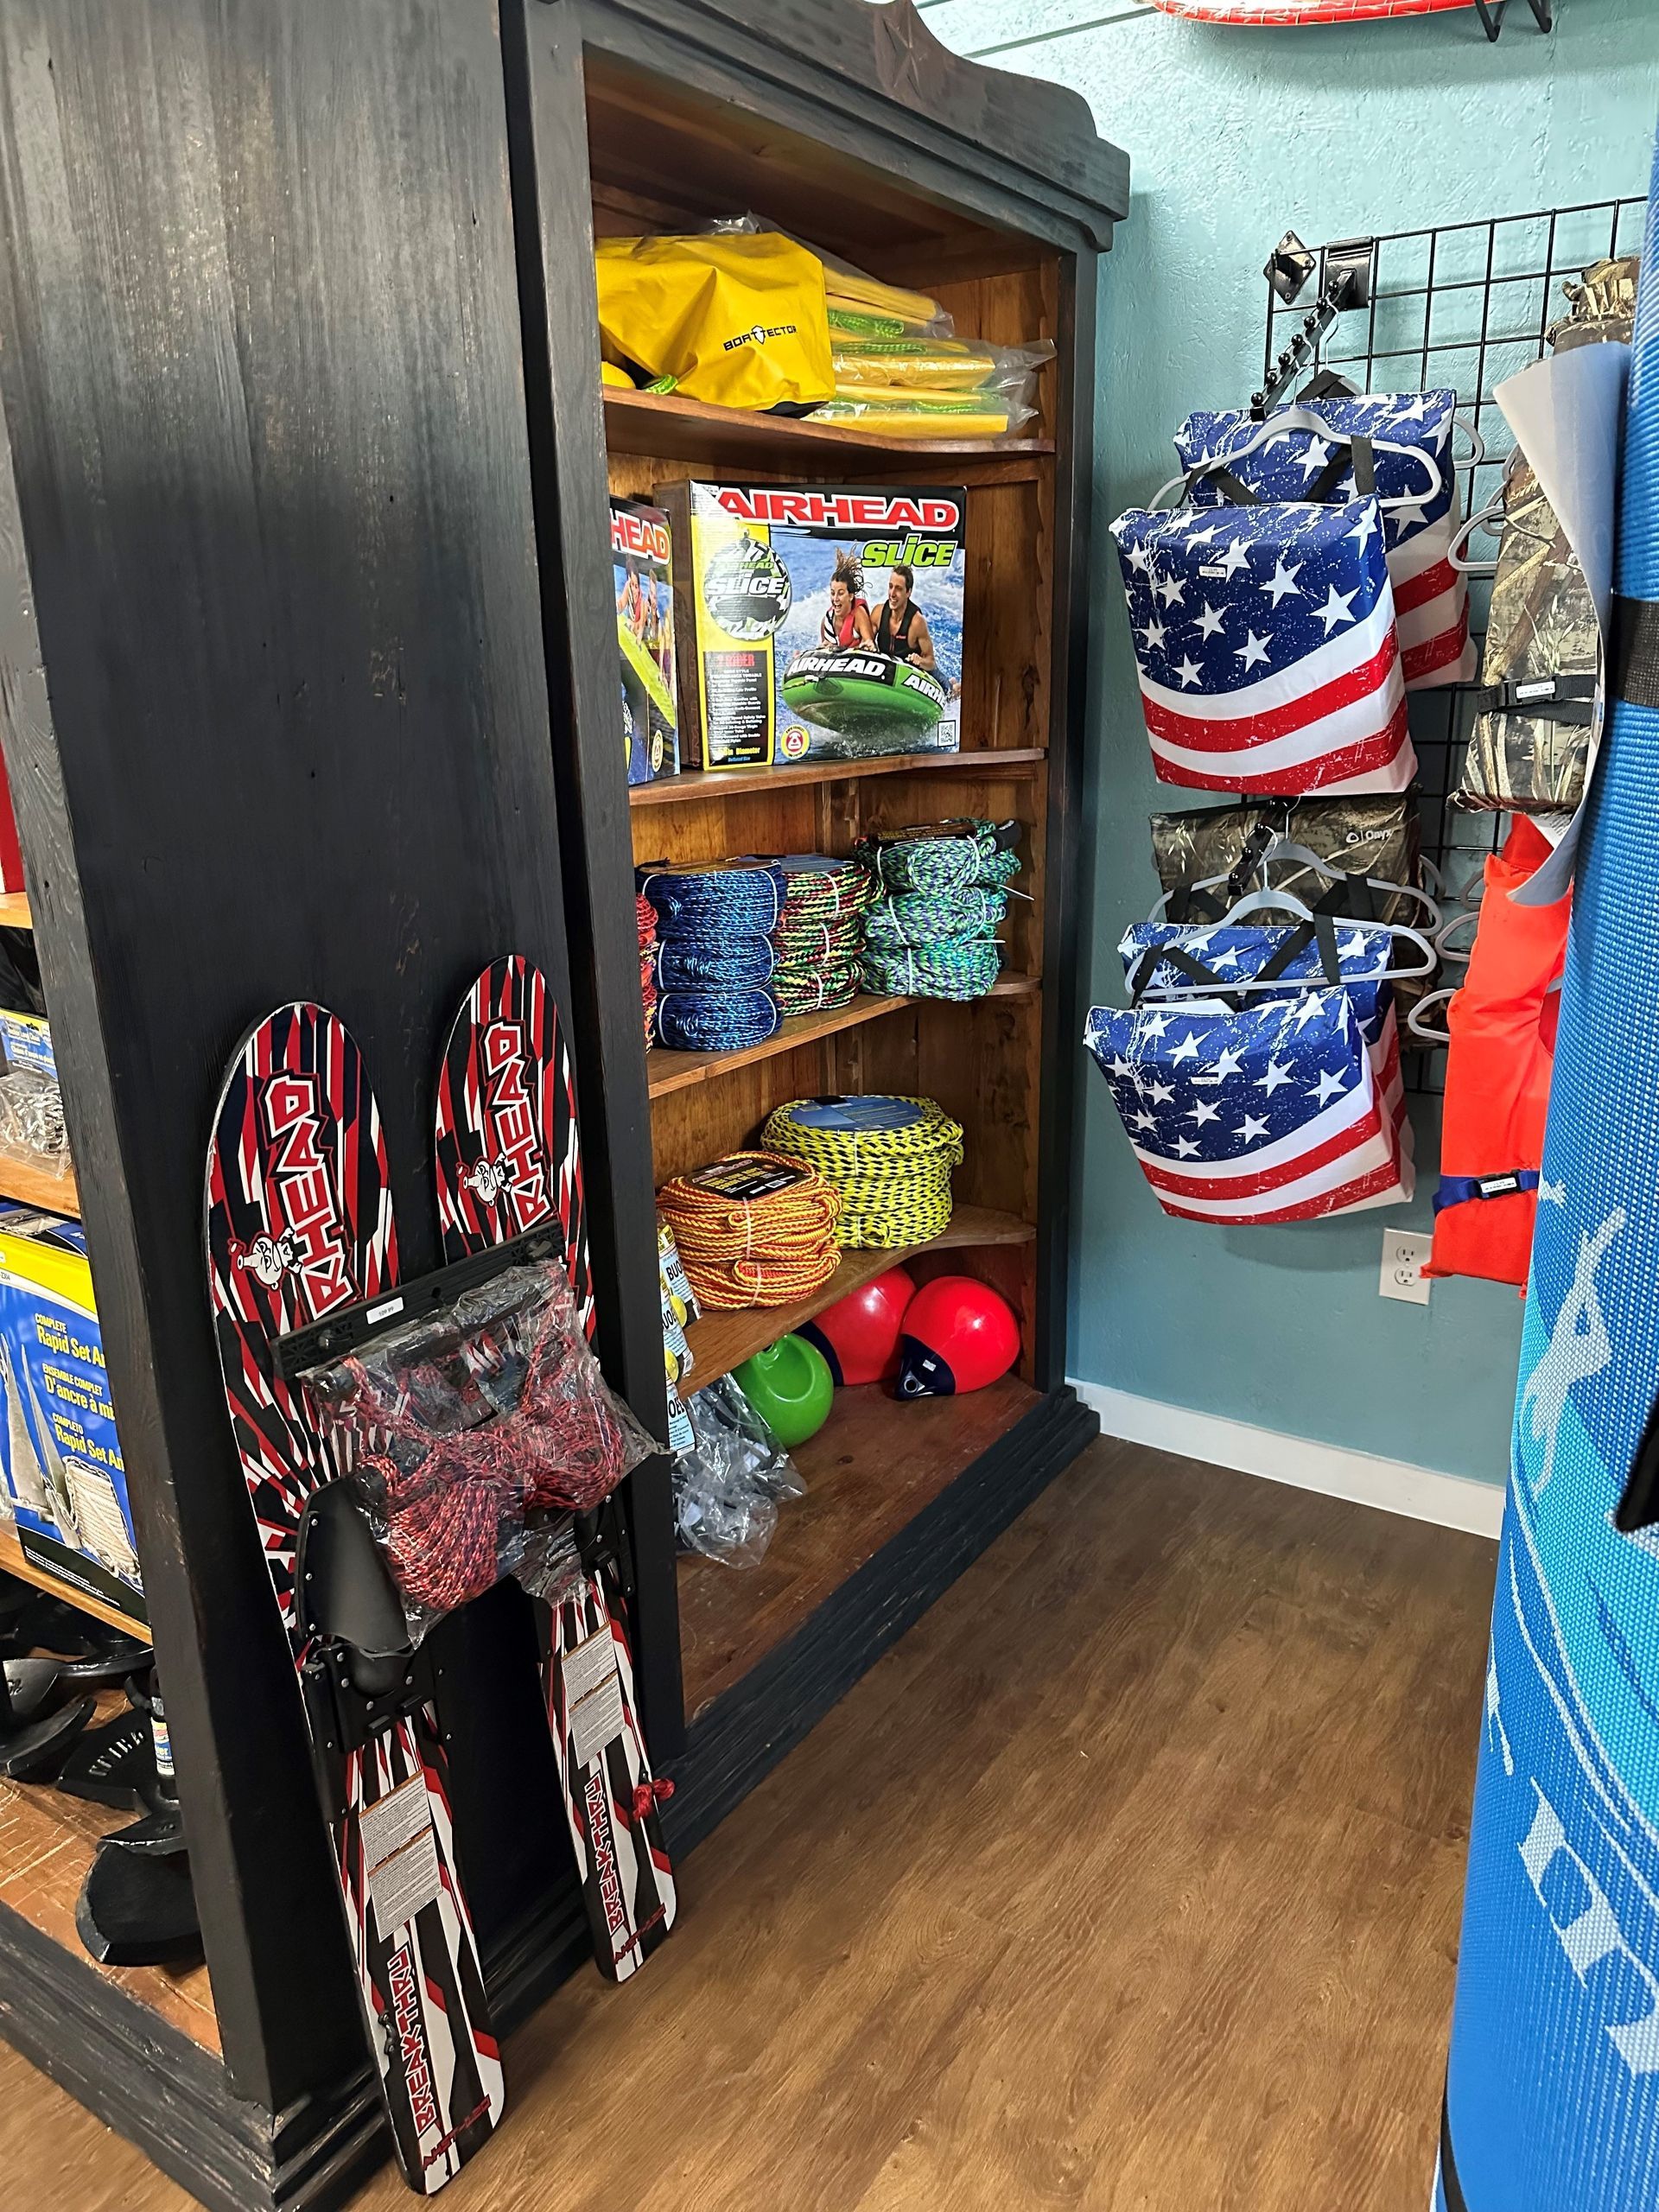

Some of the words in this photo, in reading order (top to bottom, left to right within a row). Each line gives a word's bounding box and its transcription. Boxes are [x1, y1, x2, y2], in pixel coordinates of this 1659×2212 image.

[716, 486, 959, 532] AIRHEAD
[35, 1313, 67, 1334] COMPLETE
[36, 1325, 70, 1355] Rapid
[70, 1338, 92, 1363] Set
[44, 1373, 88, 1408] D'ancre
[90, 1393, 98, 1414] à
[54, 1422, 86, 1452] Rapid
[87, 1436, 108, 1465] Set
